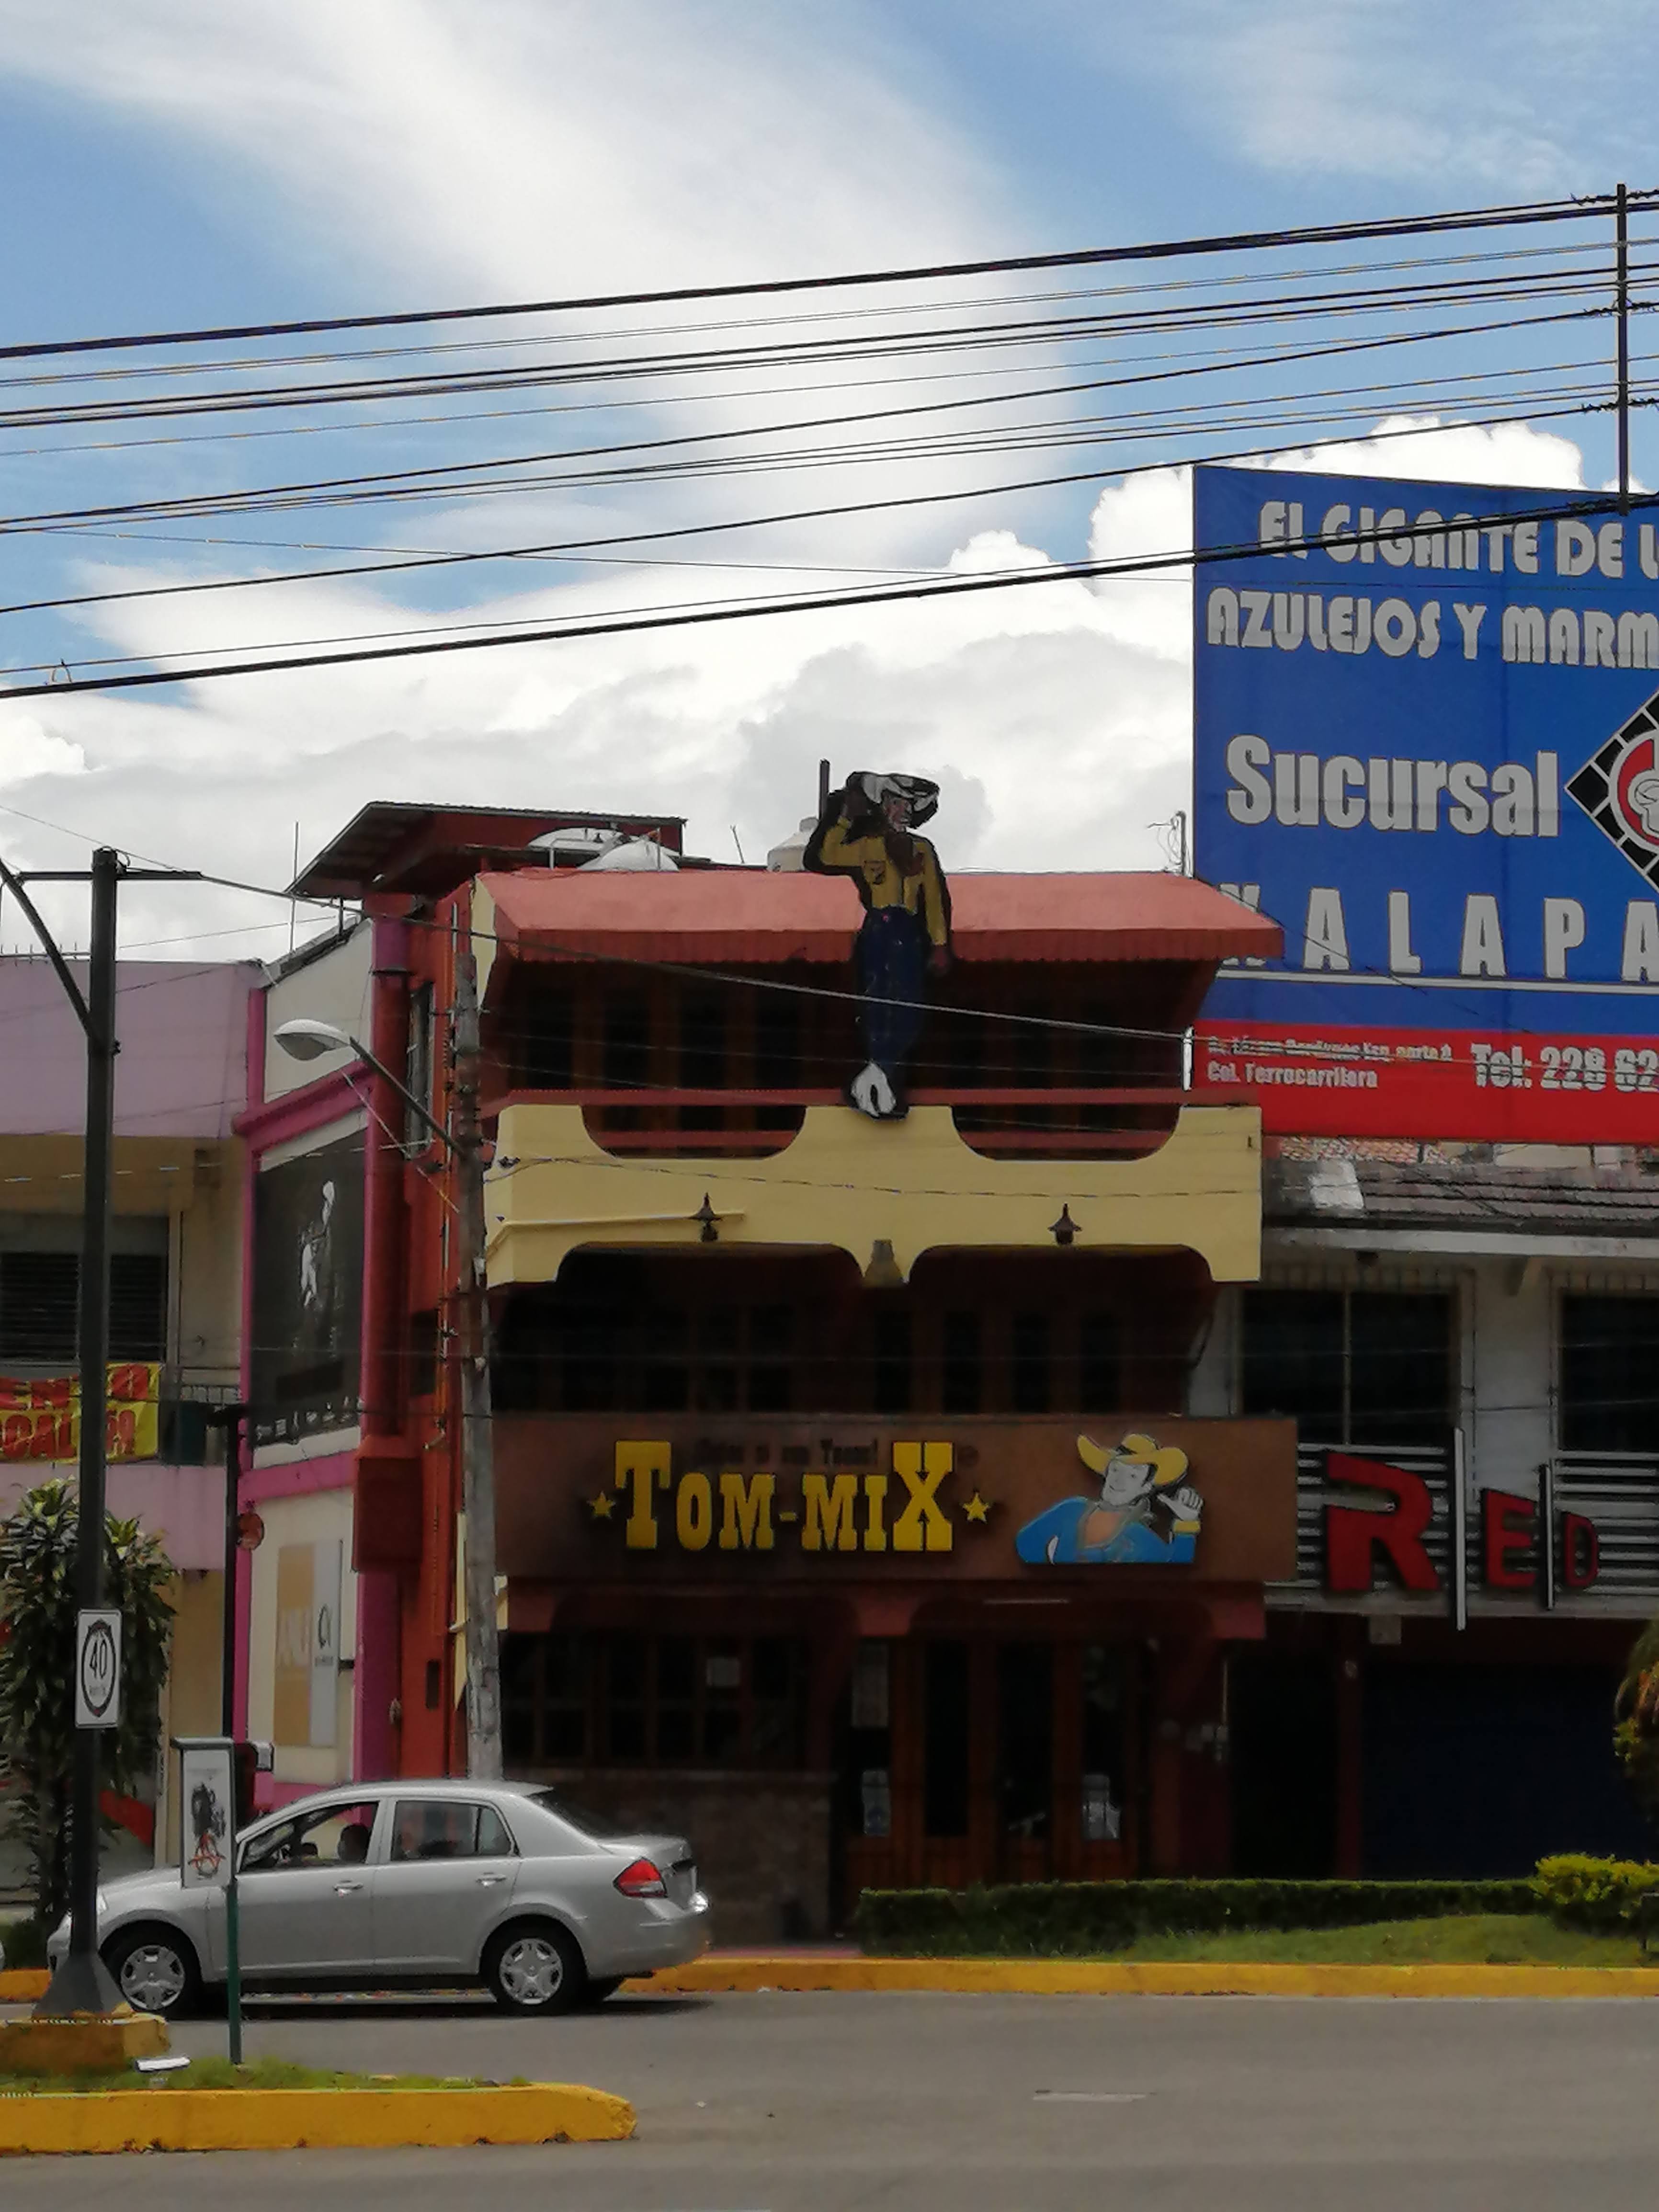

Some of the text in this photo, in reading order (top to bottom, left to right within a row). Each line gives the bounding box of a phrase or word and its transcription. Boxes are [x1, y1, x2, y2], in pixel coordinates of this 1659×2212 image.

[1555, 519, 1625, 580] DE
[1639, 524, 1659, 581] L
[1207, 587, 1659, 671] AZULEJOS Y MARM
[1226, 734, 1560, 838] Sucursal
[1539, 1046, 1608, 1092] 228
[1327, 1452, 1600, 1591] RED
[89, 1638, 108, 1679] 40
